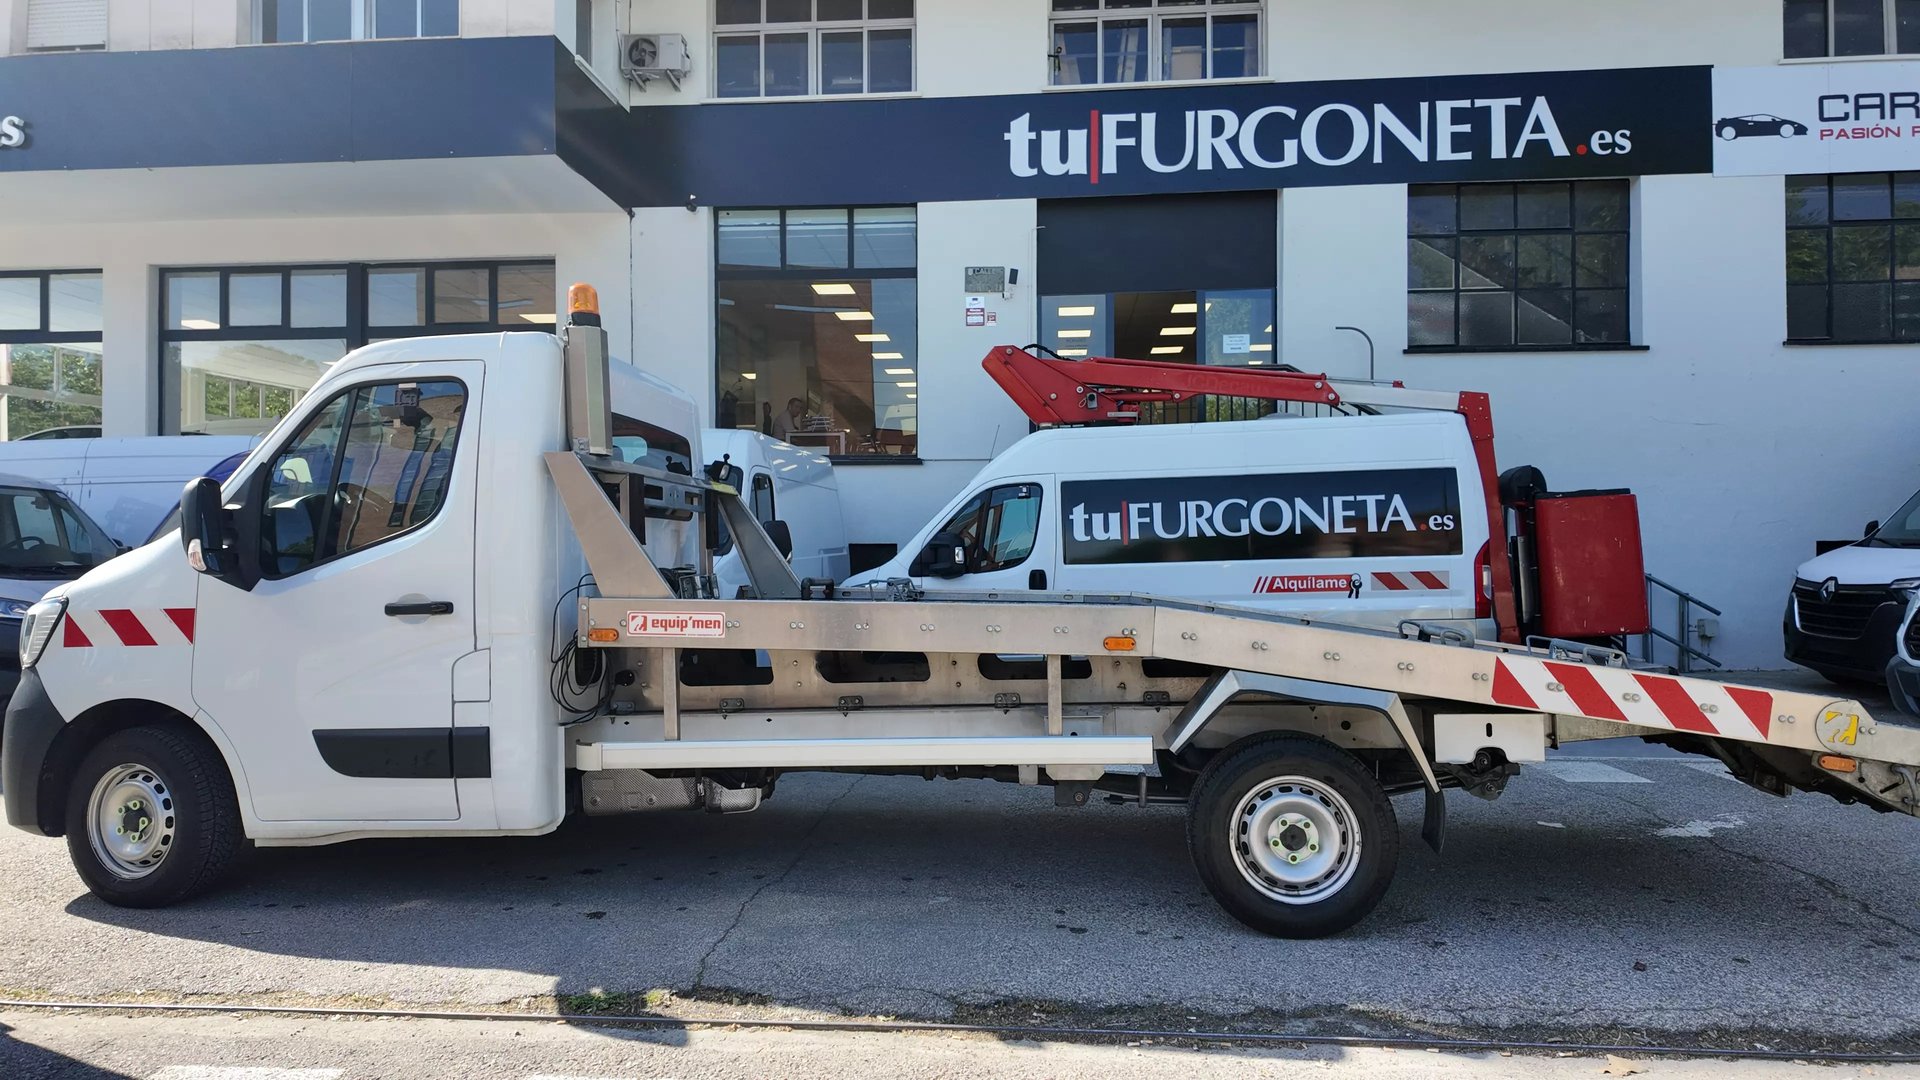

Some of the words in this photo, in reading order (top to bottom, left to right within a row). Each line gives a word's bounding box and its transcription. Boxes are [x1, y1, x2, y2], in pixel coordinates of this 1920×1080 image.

[1820, 123, 1901, 140] PASIÓN
[1273, 576, 1347, 592] Alquílame
[651, 616, 721, 632] equip'men
